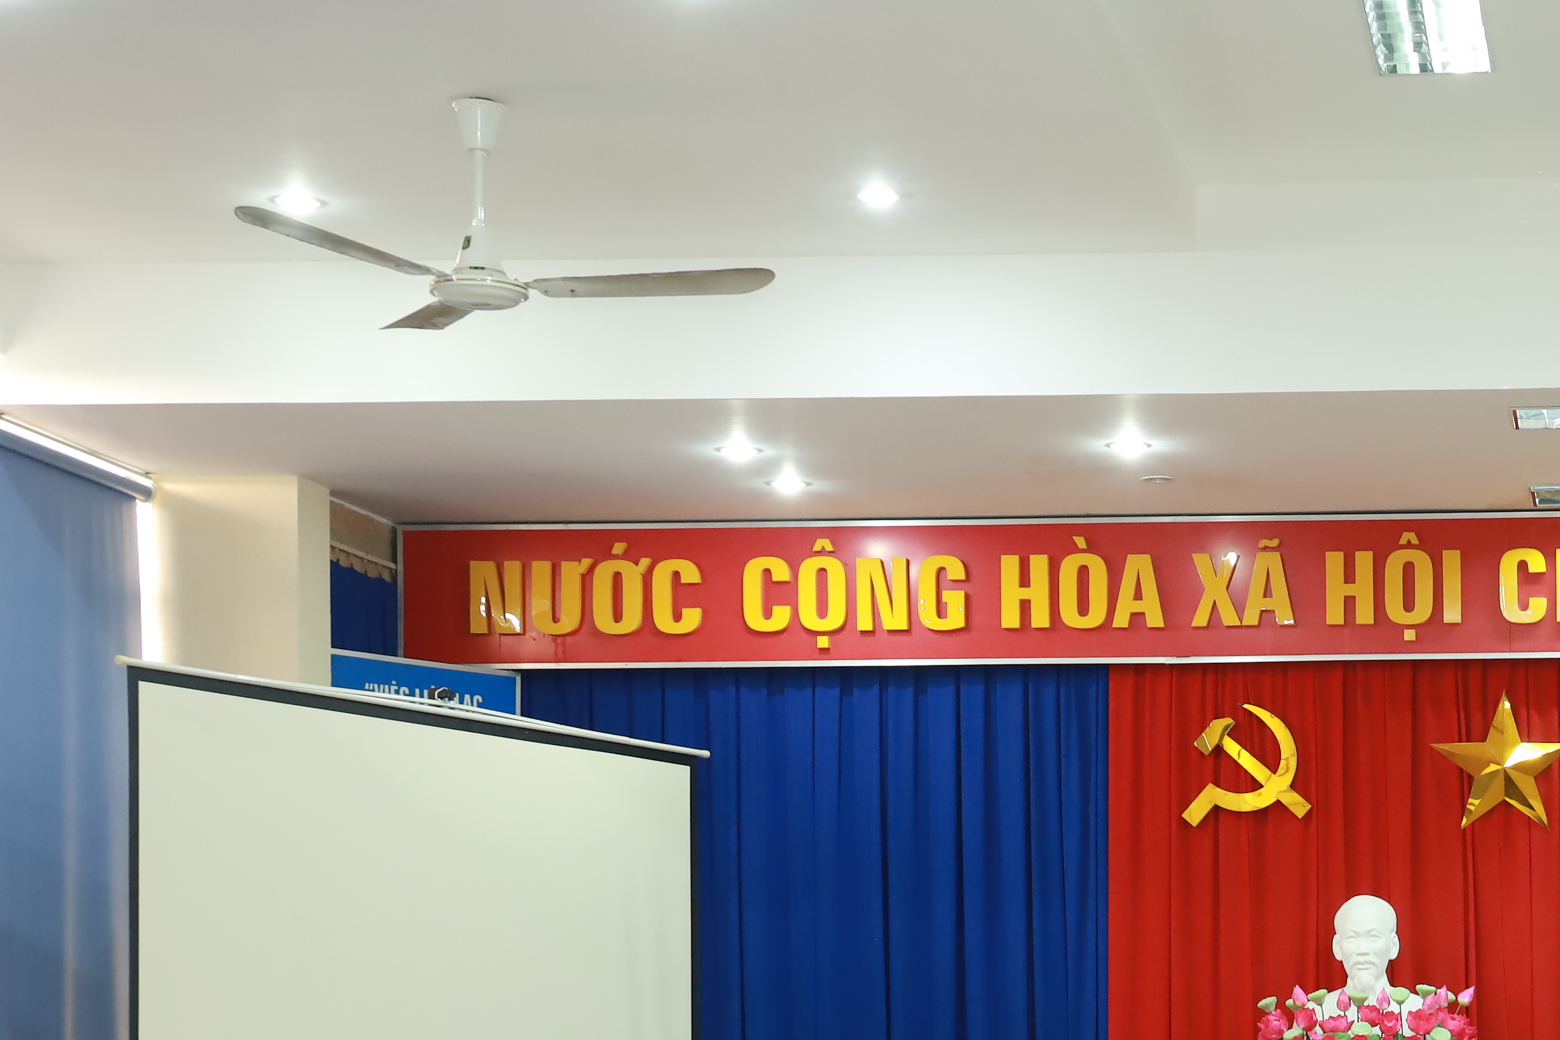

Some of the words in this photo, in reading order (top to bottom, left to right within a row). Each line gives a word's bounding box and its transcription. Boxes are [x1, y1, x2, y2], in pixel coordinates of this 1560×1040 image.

[468, 542, 703, 635] NƯỚC
[743, 538, 967, 649] CỘNG
[1001, 535, 1166, 629] HÒA
[1191, 538, 1295, 627] XÃ
[1326, 531, 1463, 641] HỘI
